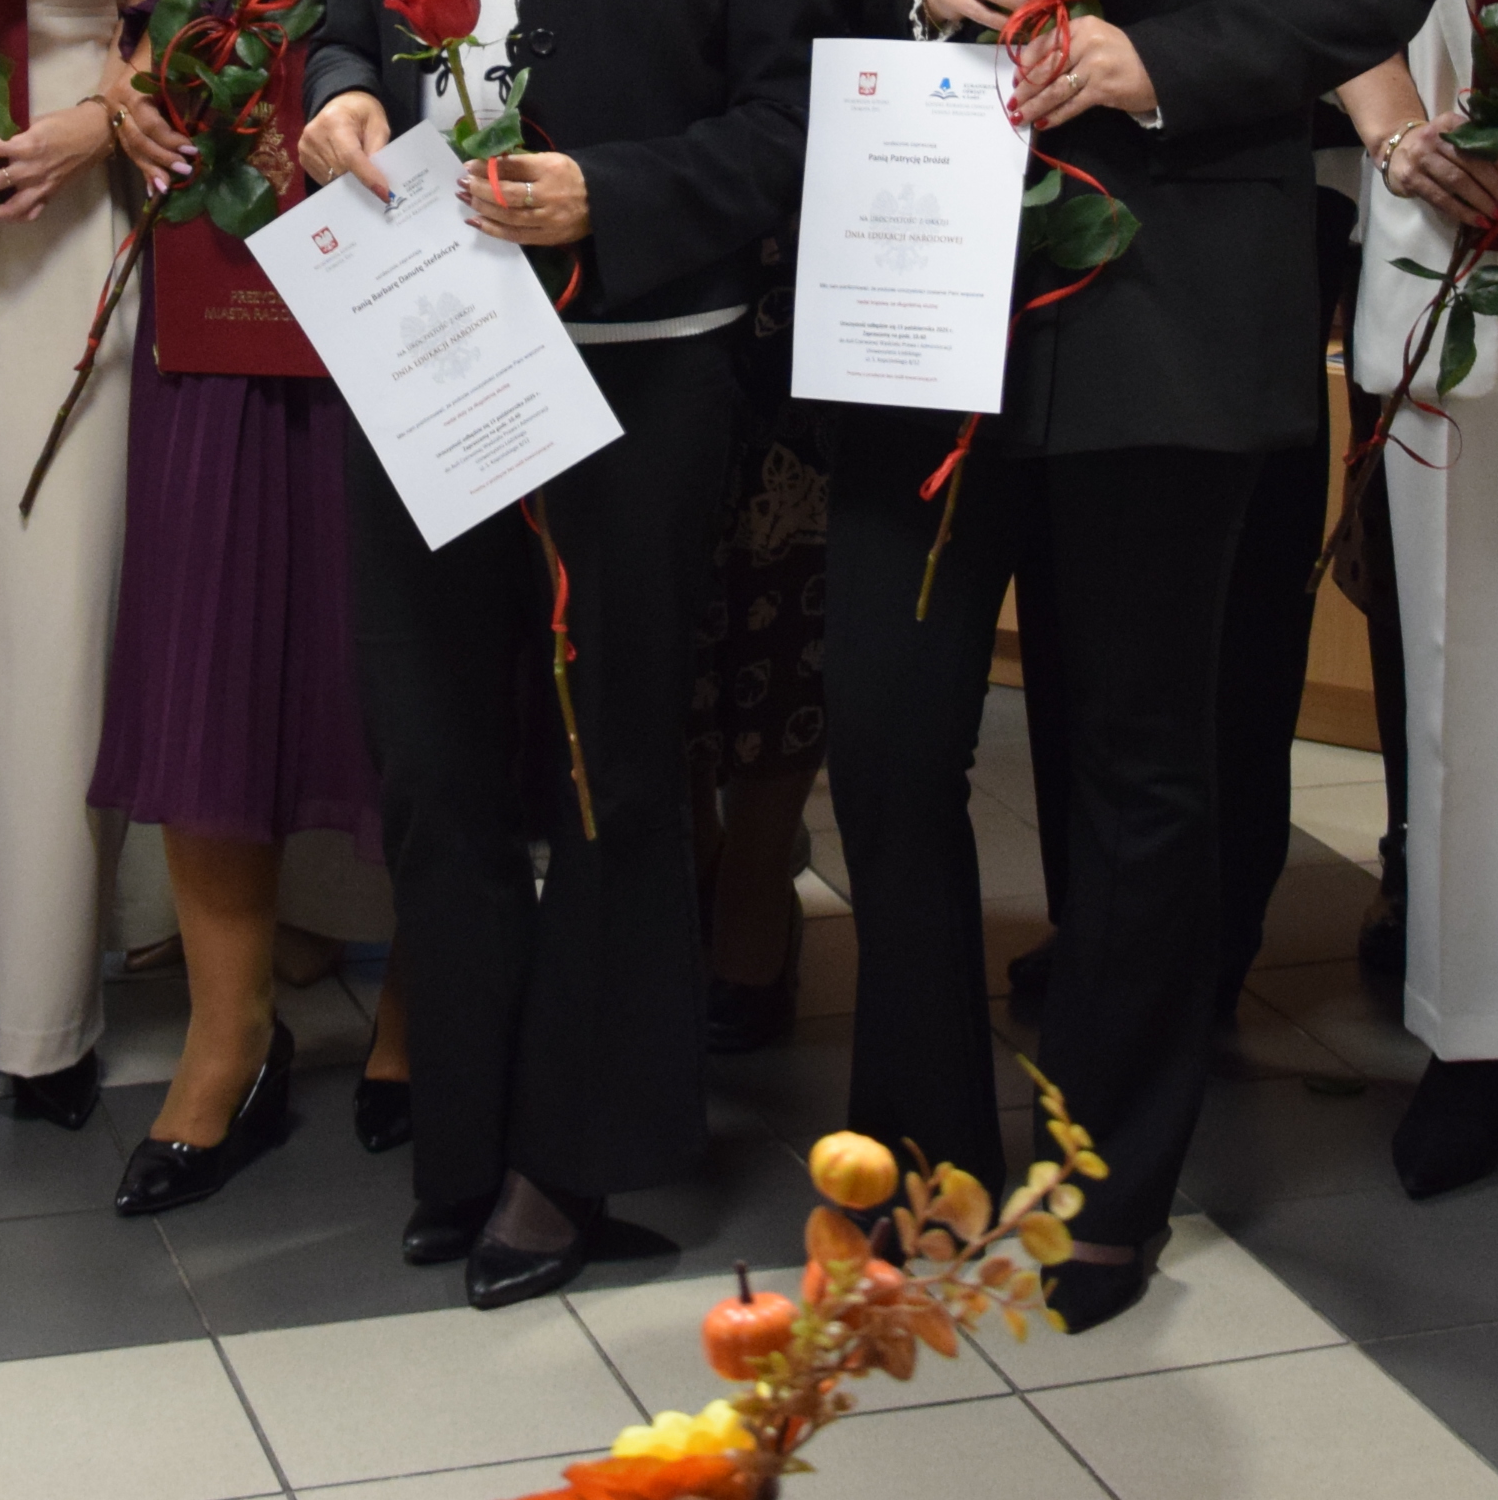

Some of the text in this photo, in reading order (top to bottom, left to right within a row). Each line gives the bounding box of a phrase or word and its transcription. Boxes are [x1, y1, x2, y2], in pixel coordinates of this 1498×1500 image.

[352, 299, 373, 314] Panią
[371, 281, 399, 301] Barbarę
[398, 265, 425, 284] Danutę
[423, 240, 460, 272] Stefańczyk
